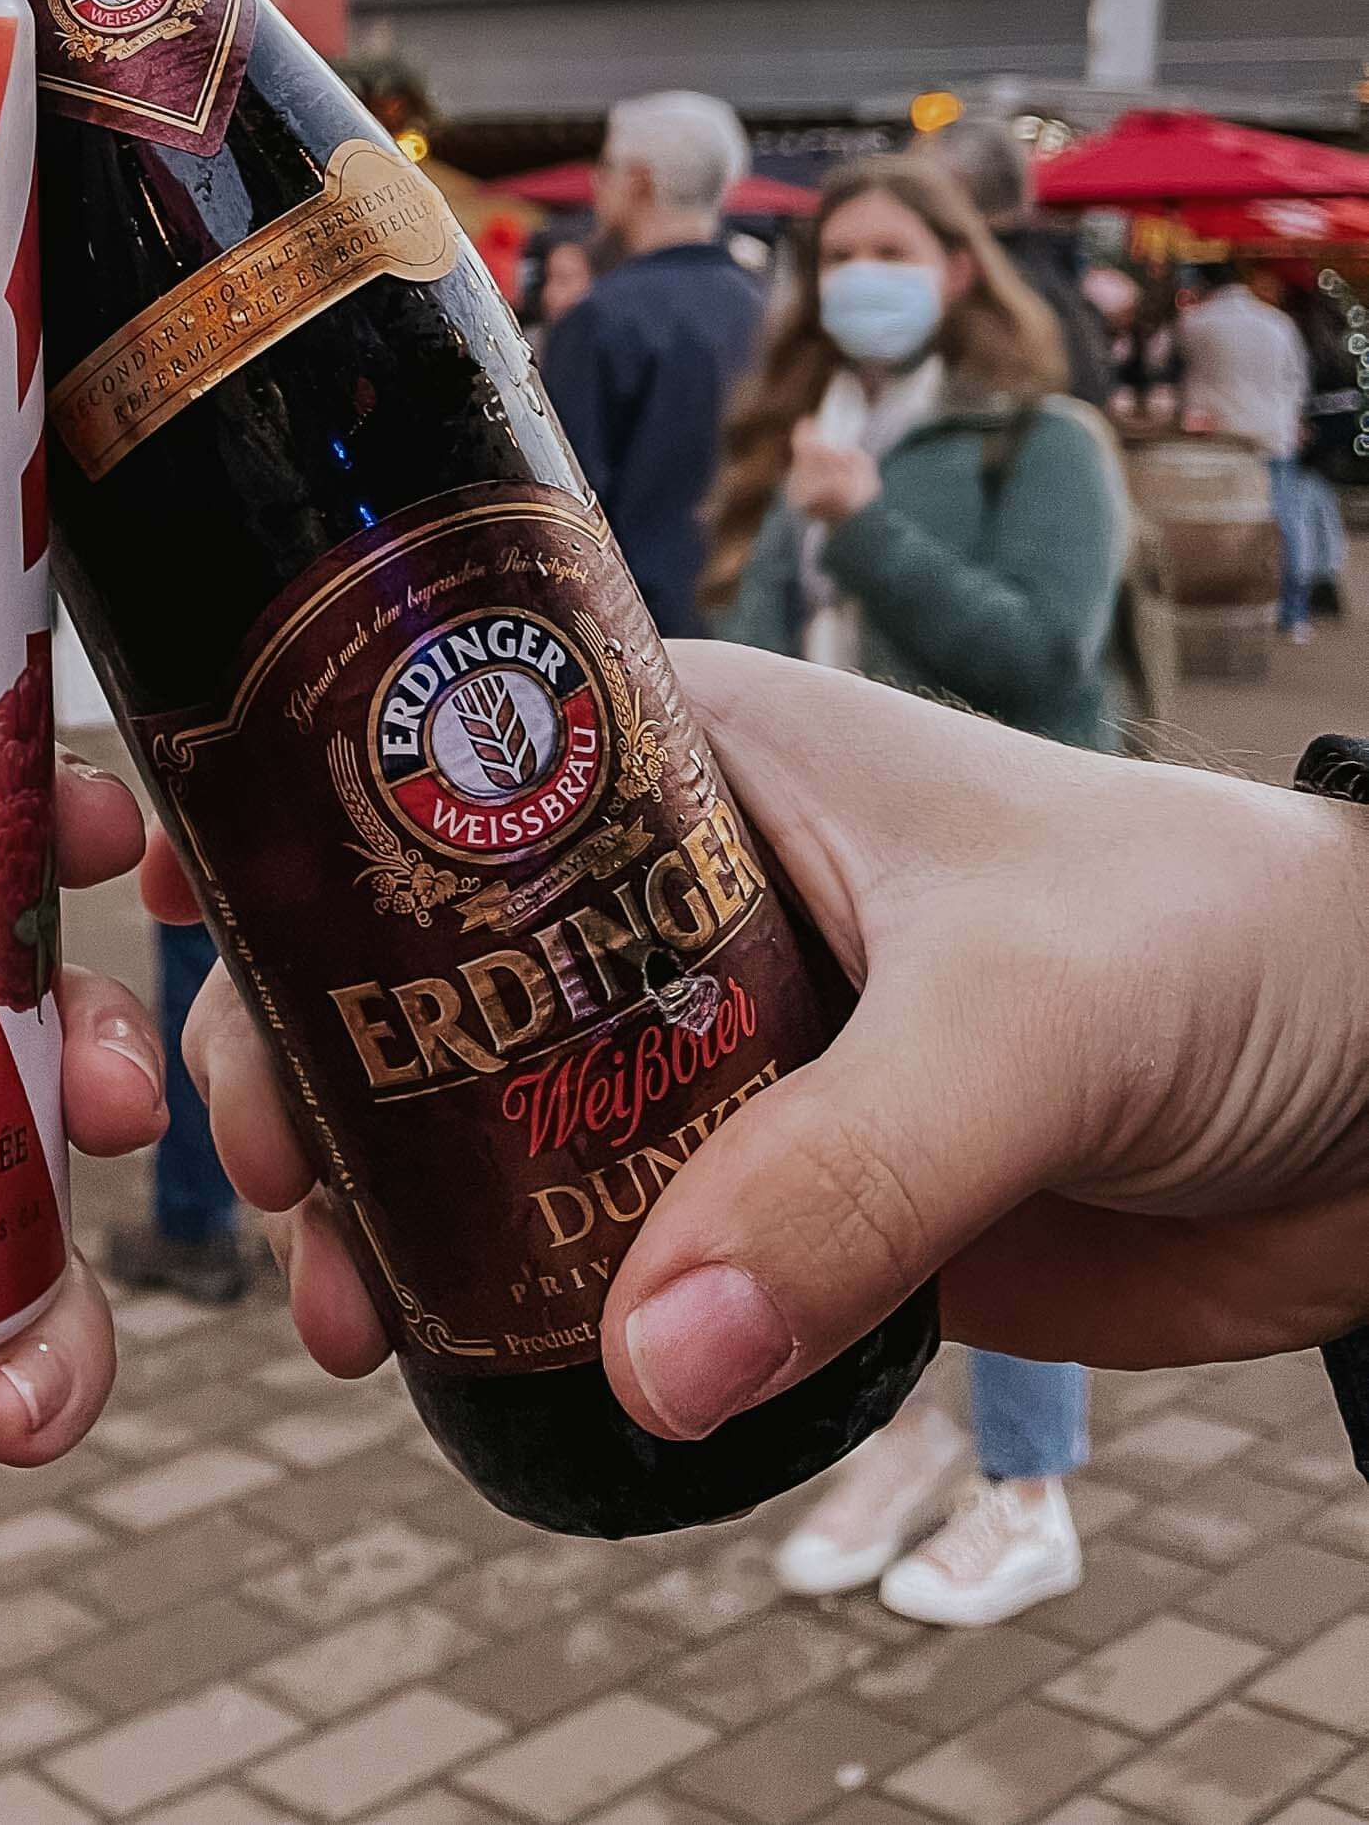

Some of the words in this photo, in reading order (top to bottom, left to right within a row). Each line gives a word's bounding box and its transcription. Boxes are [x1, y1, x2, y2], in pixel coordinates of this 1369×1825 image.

[295, 258, 328, 290] EN
[334, 200, 433, 264] BOUTEILLE
[69, 312, 198, 420] ECONDARY
[203, 241, 296, 317] BOTTLE
[339, 620, 371, 667] nach
[373, 606, 403, 634] dem
[383, 620, 566, 756] ERDINGER
[432, 726, 597, 845] WEISSBRÄU
[327, 797, 767, 1088] ERDINGER
